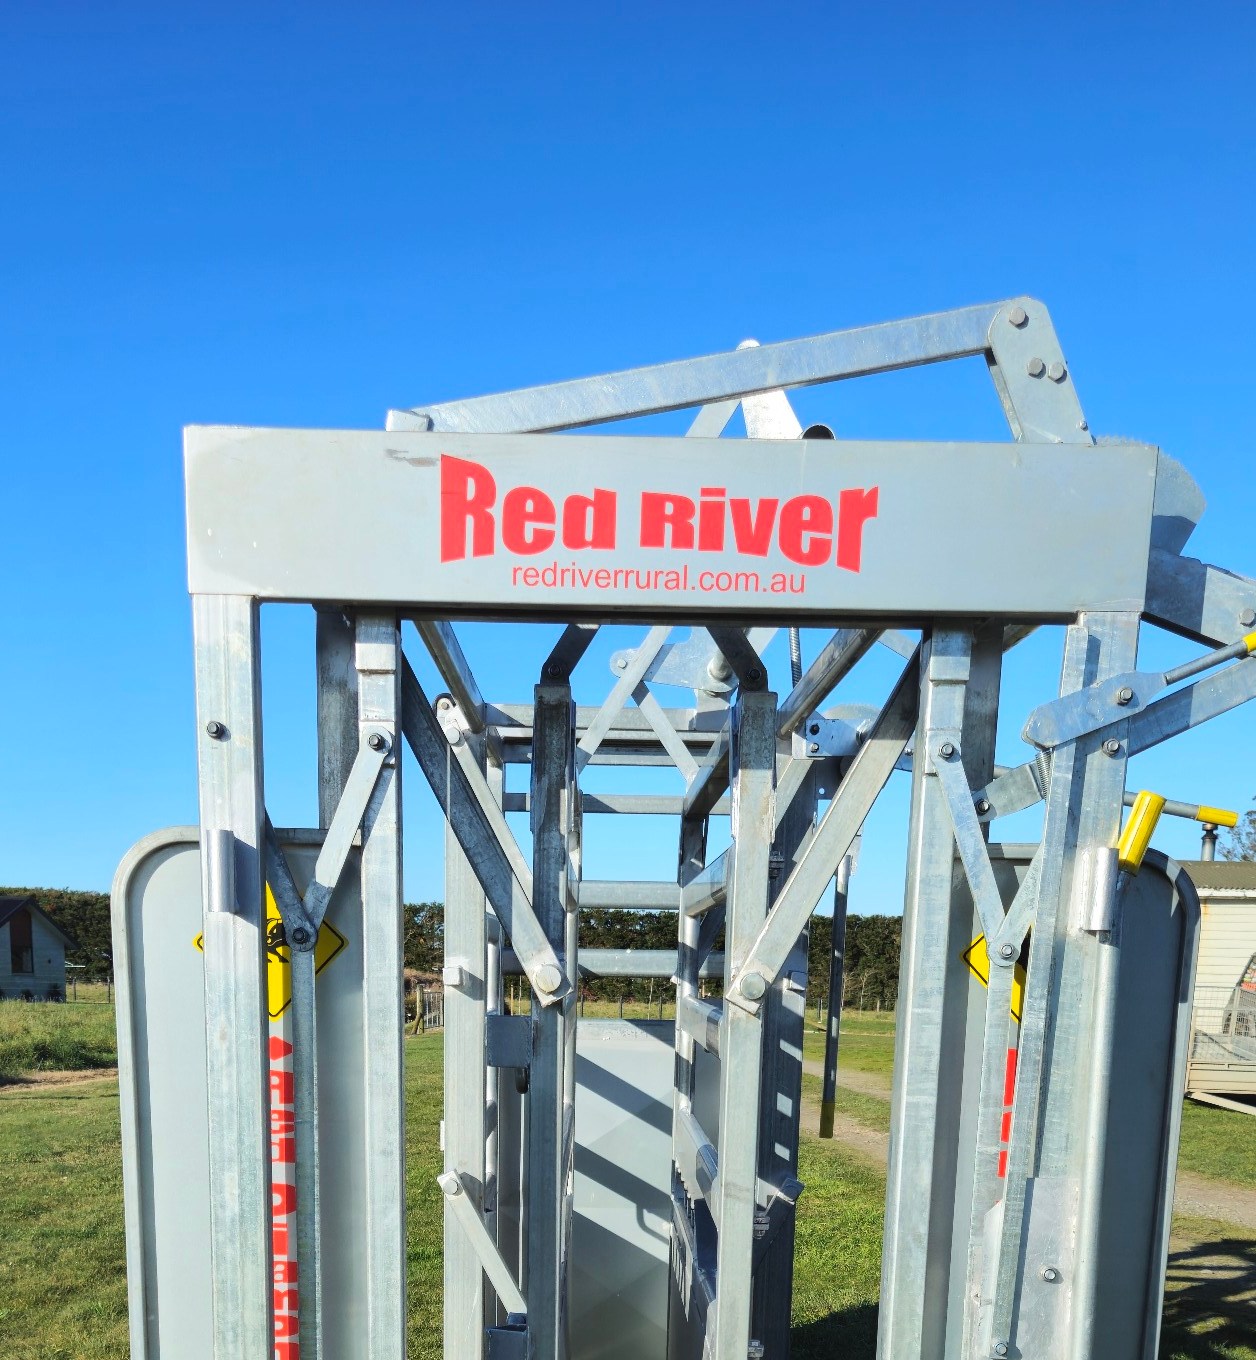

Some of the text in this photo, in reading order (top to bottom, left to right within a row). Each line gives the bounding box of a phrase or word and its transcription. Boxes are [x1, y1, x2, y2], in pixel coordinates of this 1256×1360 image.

[440, 453, 880, 574] Red River
[512, 561, 806, 594] redriverrural.com.au
